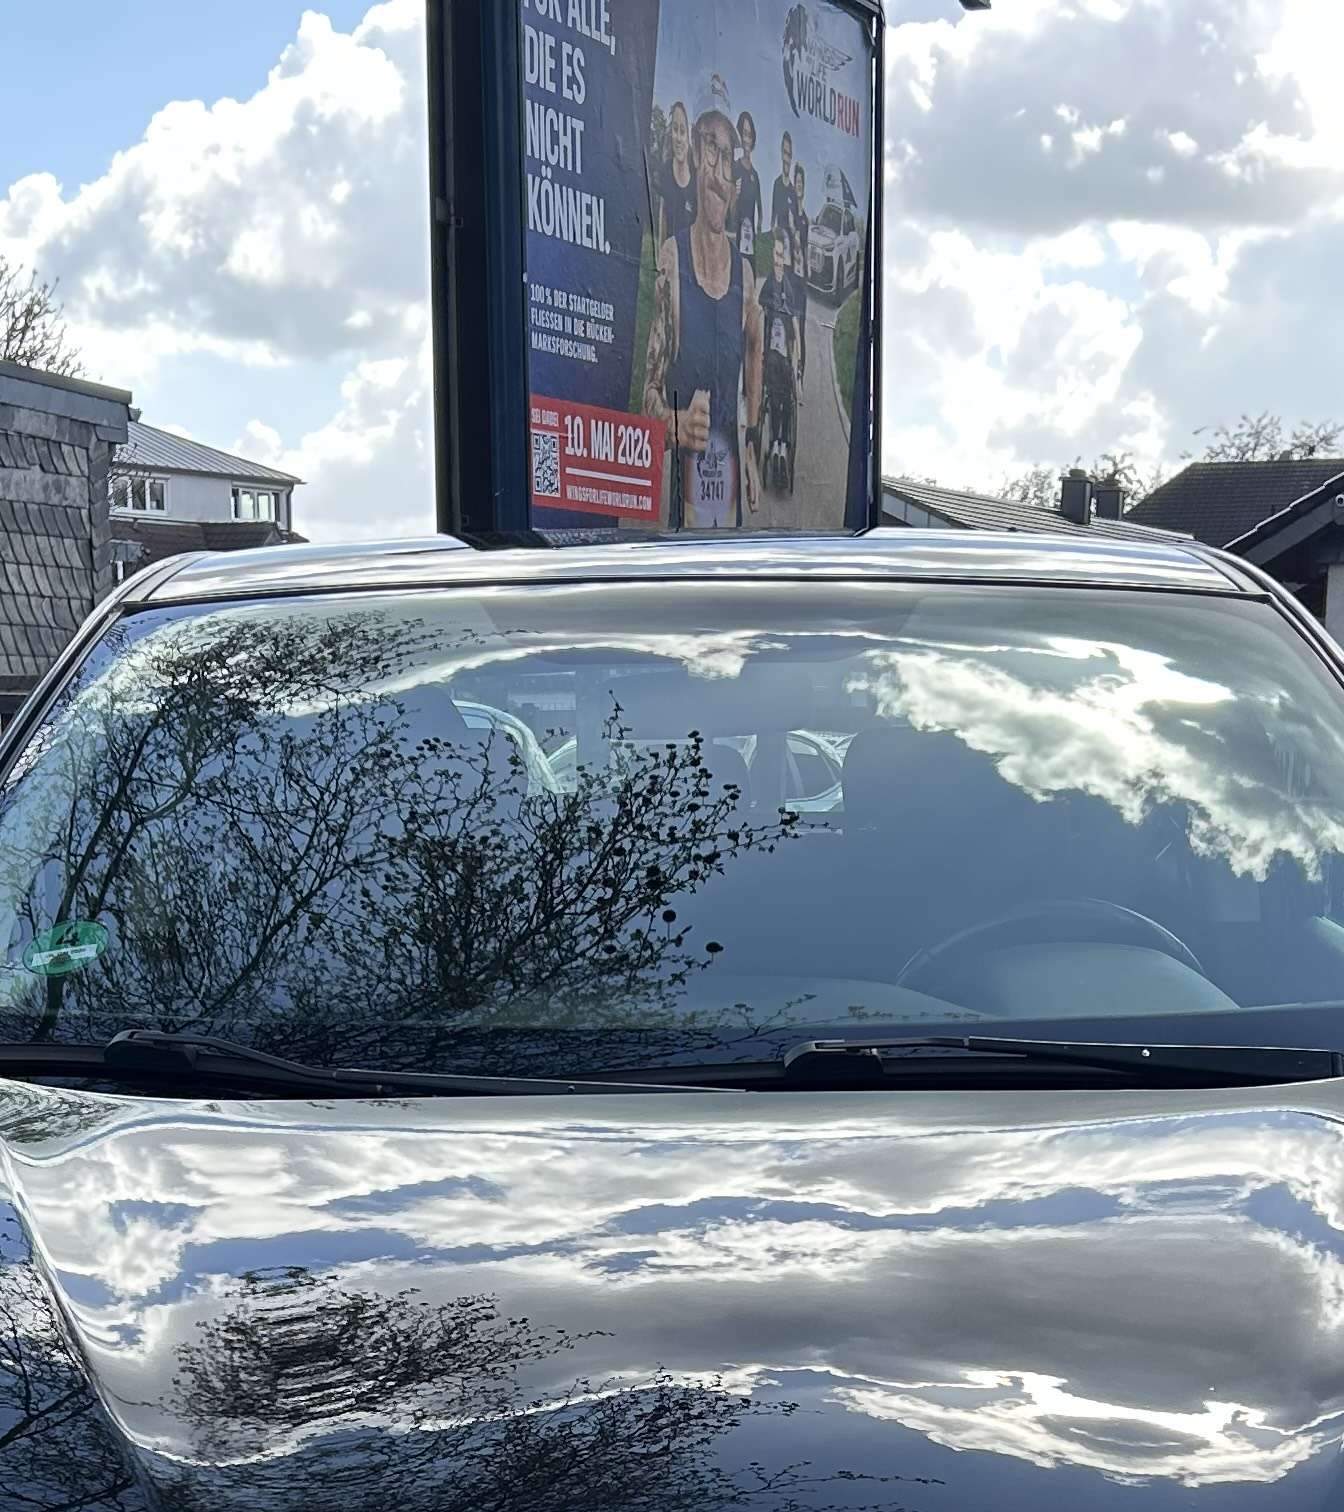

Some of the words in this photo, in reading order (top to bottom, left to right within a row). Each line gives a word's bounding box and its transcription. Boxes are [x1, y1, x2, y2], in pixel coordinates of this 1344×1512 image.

[524, 24, 556, 93] DIE
[561, 41, 586, 105] ES
[525, 98, 585, 175] NICHT
[527, 164, 611, 255] KÖNNEN.
[530, 307, 563, 332] FLIESSEN
[564, 315, 573, 334] IN
[553, 288, 568, 310] DER
[568, 293, 615, 321] STARTGELDER
[564, 414, 588, 458] 10.
[590, 419, 615, 462] MAI
[617, 424, 653, 469] 2026
